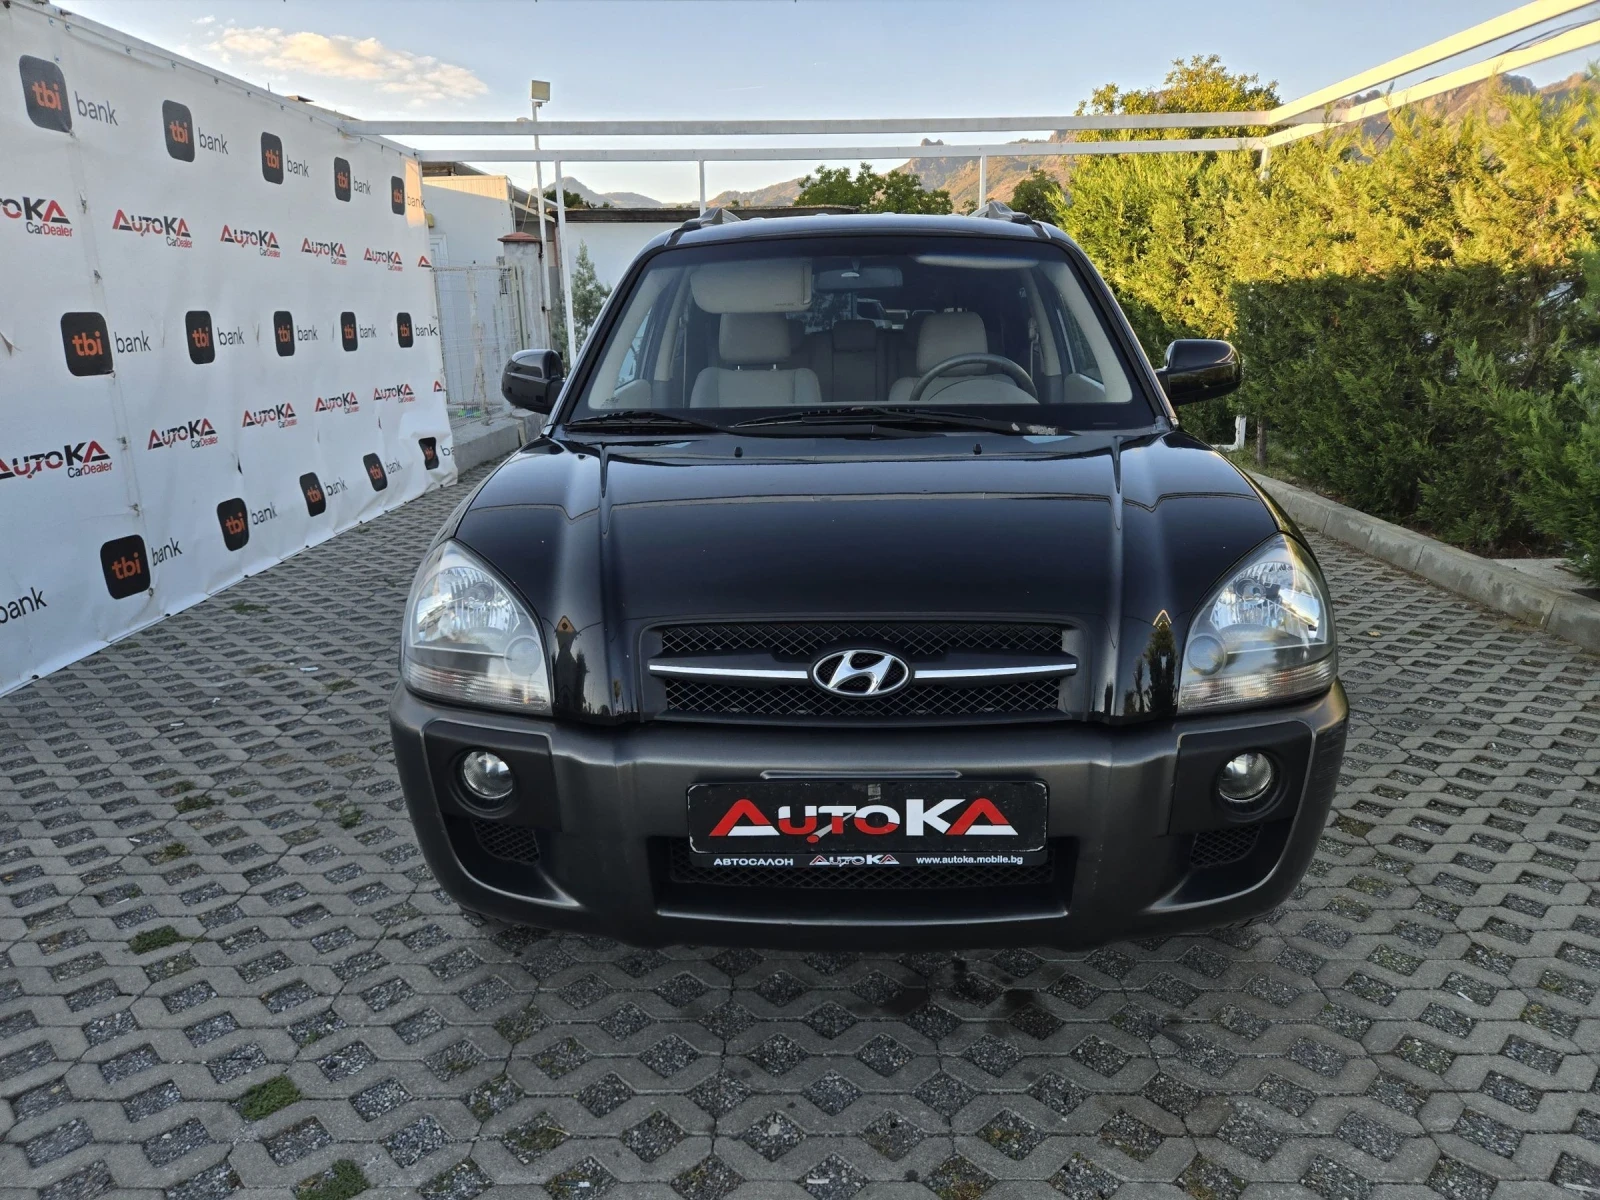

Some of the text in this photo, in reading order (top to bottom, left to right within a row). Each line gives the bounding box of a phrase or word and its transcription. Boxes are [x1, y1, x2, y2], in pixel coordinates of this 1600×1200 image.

[32, 80, 118, 126] tbi bank
[169, 120, 228, 154] tbi bank
[265, 147, 309, 177] tbi bank
[353, 176, 371, 195] bank
[0, 196, 71, 224] OKA
[26, 221, 73, 237] CarDealer
[192, 326, 245, 348] tbi bank
[278, 325, 318, 343] tbi bank
[359, 324, 377, 339] bank
[415, 324, 439, 337] bank
[72, 330, 152, 356] tbi bank
[67, 462, 113, 478] CarDealer
[325, 477, 348, 496] bank
[226, 502, 278, 535] tbi bank
[112, 537, 183, 580] tbi bank
[713, 857, 794, 866] АВТОСАЛОН
[916, 855, 1023, 866] www.autoka.mobile.bg
